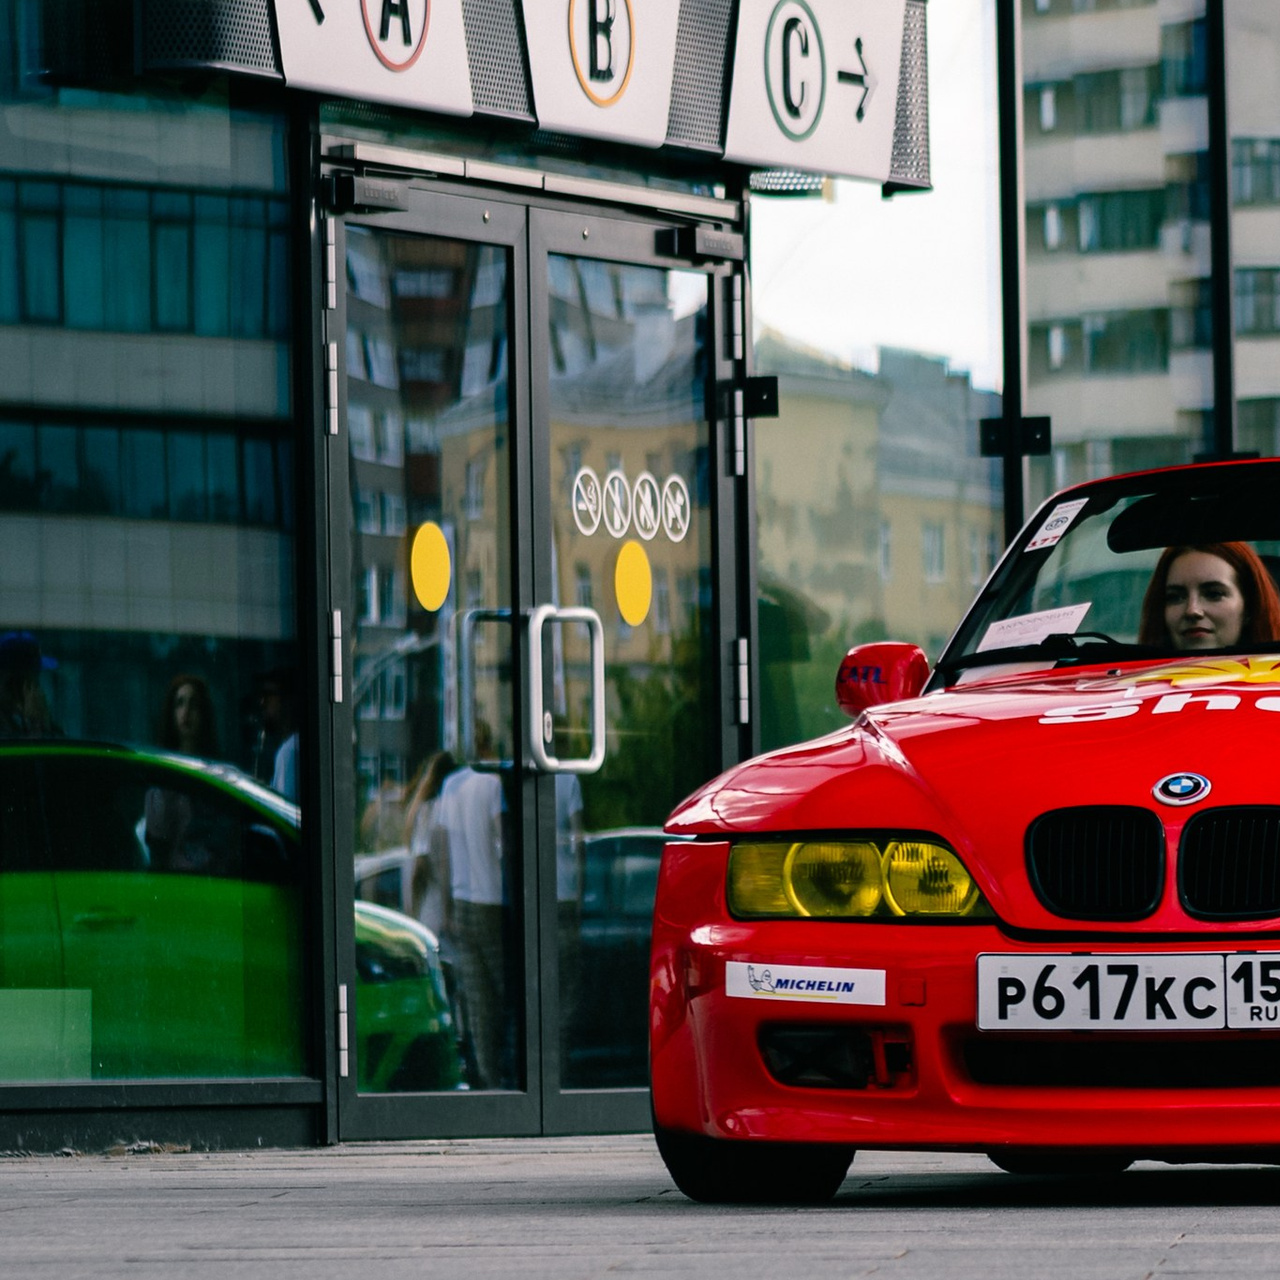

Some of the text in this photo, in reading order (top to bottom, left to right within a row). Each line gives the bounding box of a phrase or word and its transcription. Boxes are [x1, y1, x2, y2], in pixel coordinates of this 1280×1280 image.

[782, 17, 810, 118] C
[775, 978, 855, 993] MICHELIN
[998, 964, 1218, 1021] P617KC
